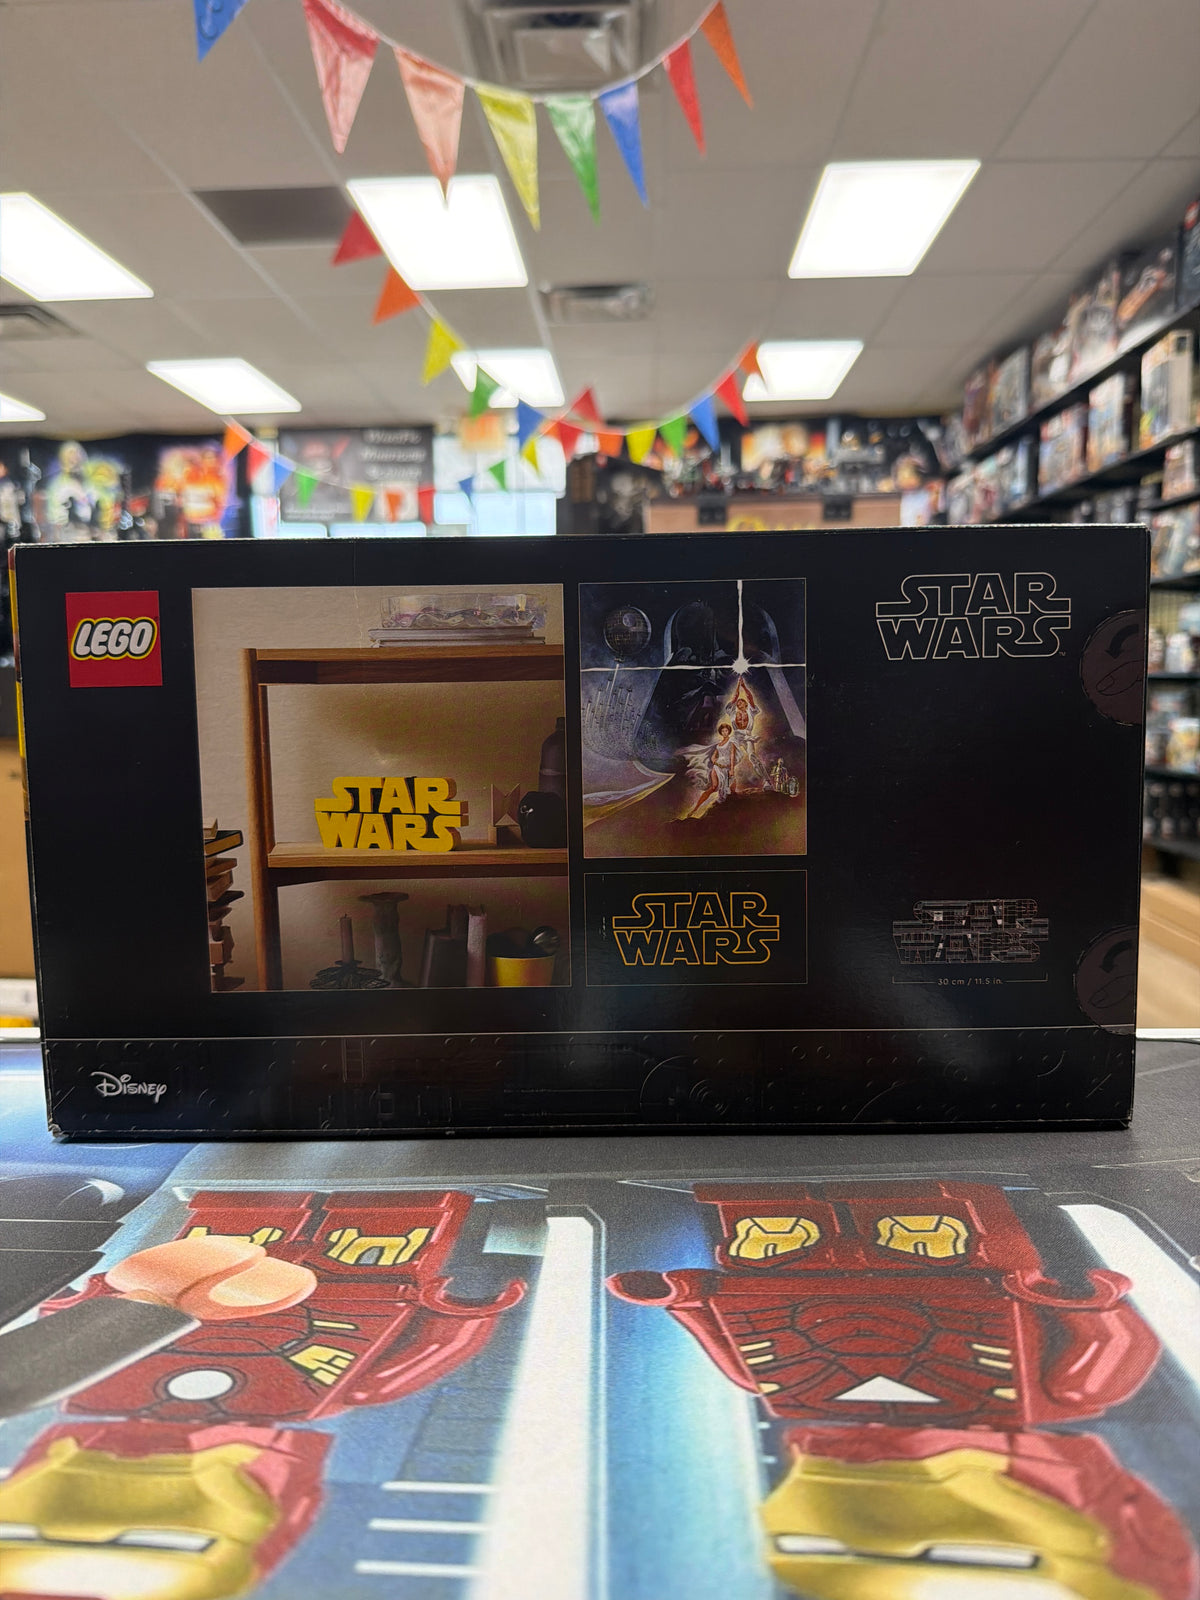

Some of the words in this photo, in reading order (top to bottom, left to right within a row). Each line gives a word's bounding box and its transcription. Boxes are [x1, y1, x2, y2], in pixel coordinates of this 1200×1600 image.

[876, 571, 1071, 617] STAR
[73, 619, 156, 658] LEGO
[876, 615, 1071, 661] WARS
[314, 776, 469, 814] STAR
[314, 811, 469, 853] WARS
[612, 892, 780, 929] STAR
[613, 928, 780, 966] WARS
[937, 978, 949, 986] 30
[975, 977, 990, 985] 11.5
